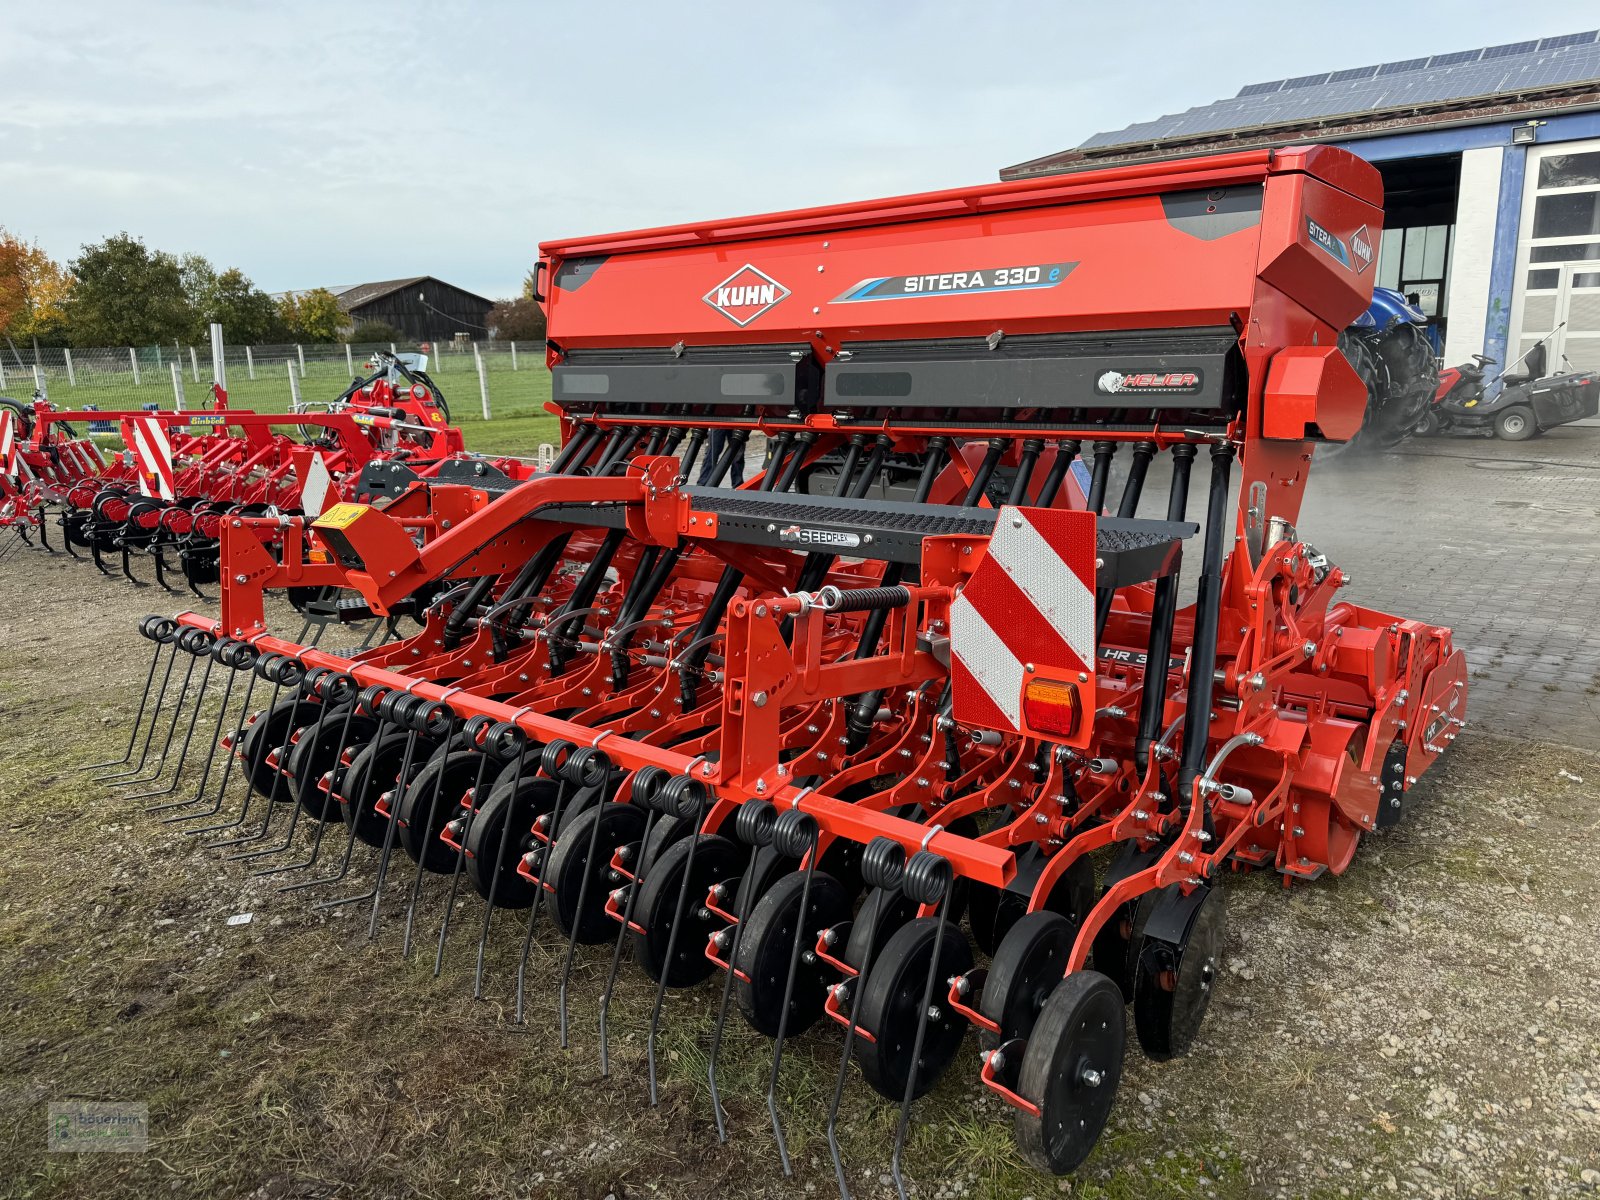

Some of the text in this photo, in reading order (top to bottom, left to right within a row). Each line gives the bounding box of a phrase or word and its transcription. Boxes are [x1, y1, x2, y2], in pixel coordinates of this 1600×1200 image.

[1309, 221, 1331, 248] SITERA
[1354, 236, 1371, 262] KUHN
[904, 266, 1060, 293] SITERA 330 e
[716, 284, 775, 307] KUHN
[1122, 373, 1196, 387] HELICA
[799, 529, 849, 544] SEEDFLEX
[1104, 648, 1131, 661] HR
